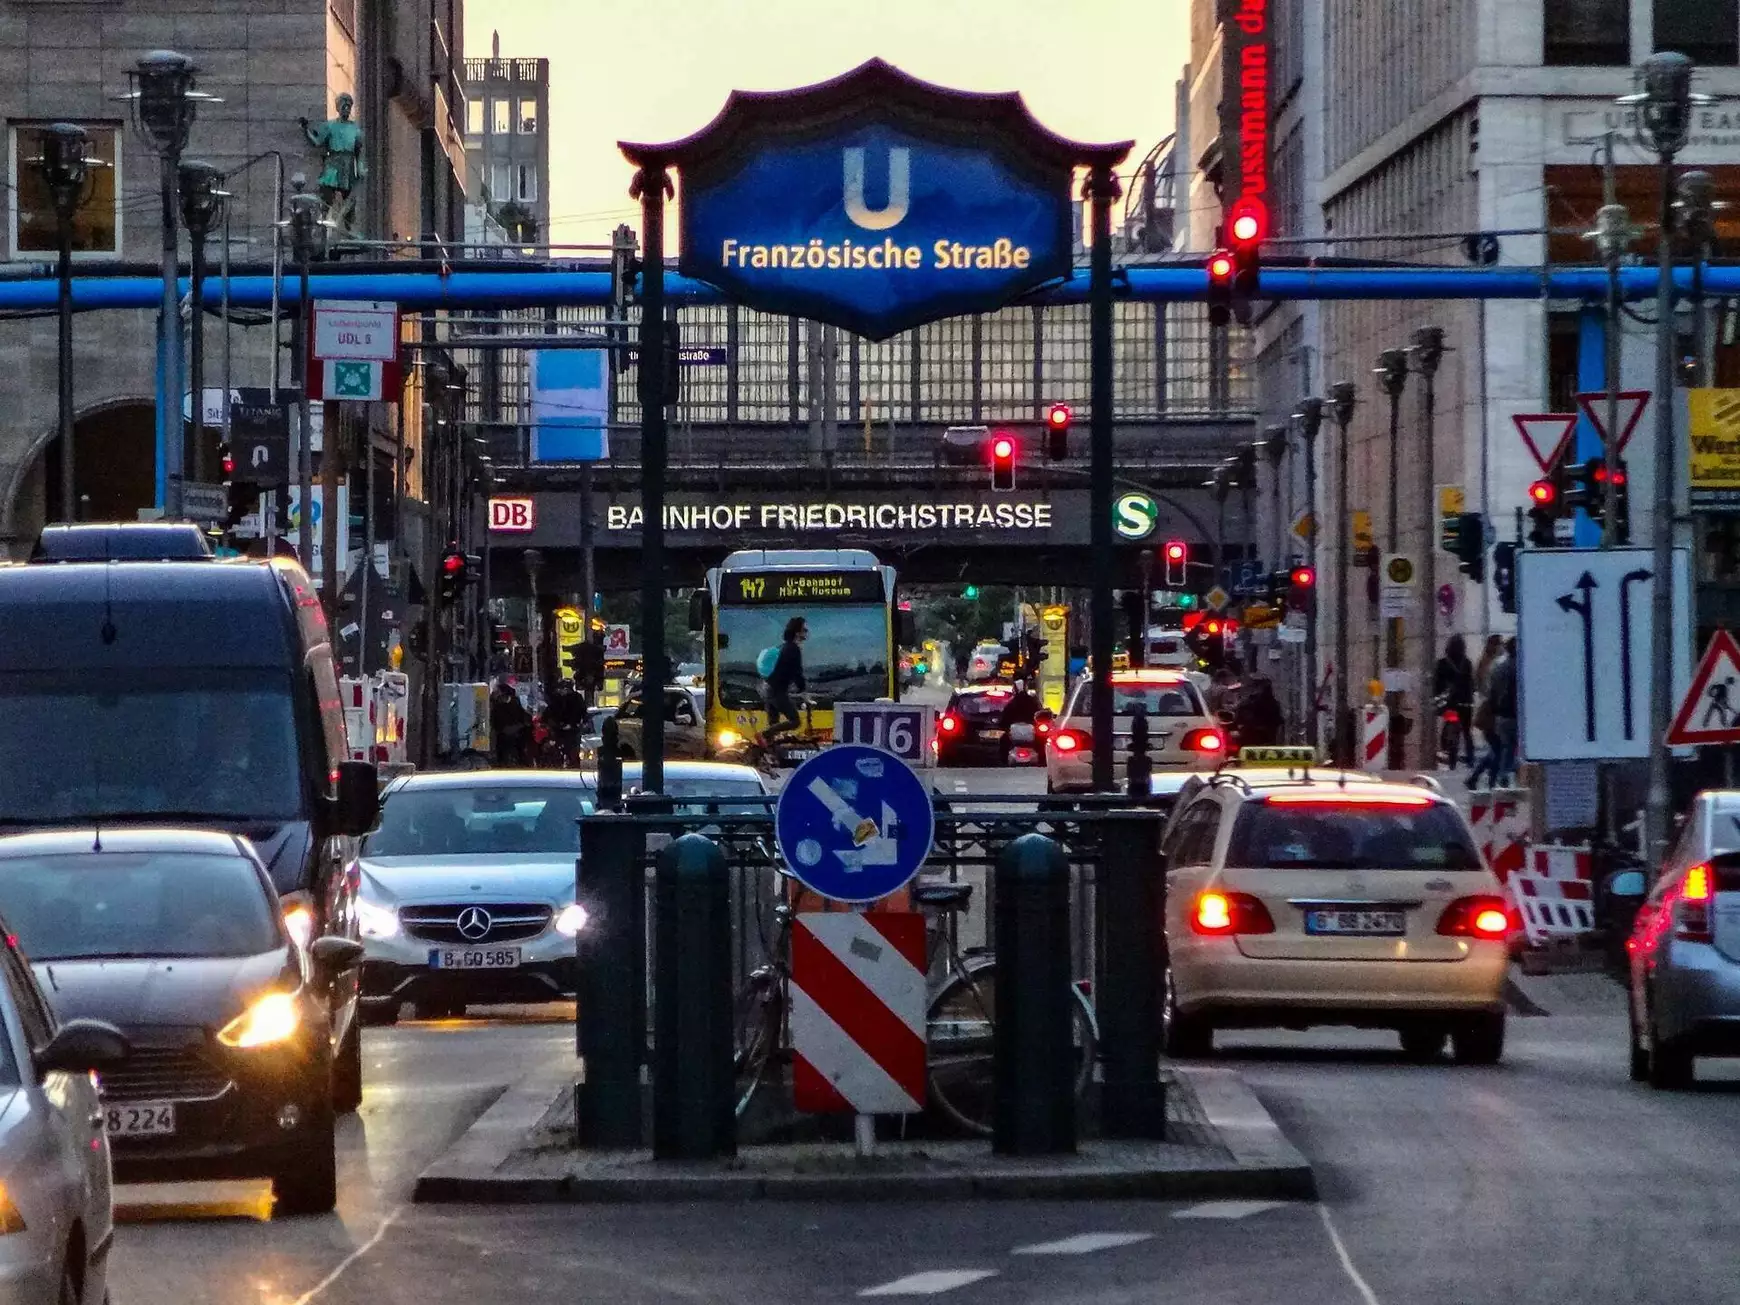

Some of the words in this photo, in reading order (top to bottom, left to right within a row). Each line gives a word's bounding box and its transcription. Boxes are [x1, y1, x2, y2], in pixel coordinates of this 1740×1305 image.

[843, 148, 910, 230] U
[722, 237, 922, 270] Französische
[933, 237, 1031, 270] Straße
[493, 503, 528, 527] DB
[761, 504, 1052, 529] FRIEDRICHSTRASSE
[1117, 496, 1150, 536] S
[740, 578, 766, 598] 147
[852, 716, 913, 754] U6
[486, 951, 514, 966] 585
[127, 1107, 171, 1132] 224
